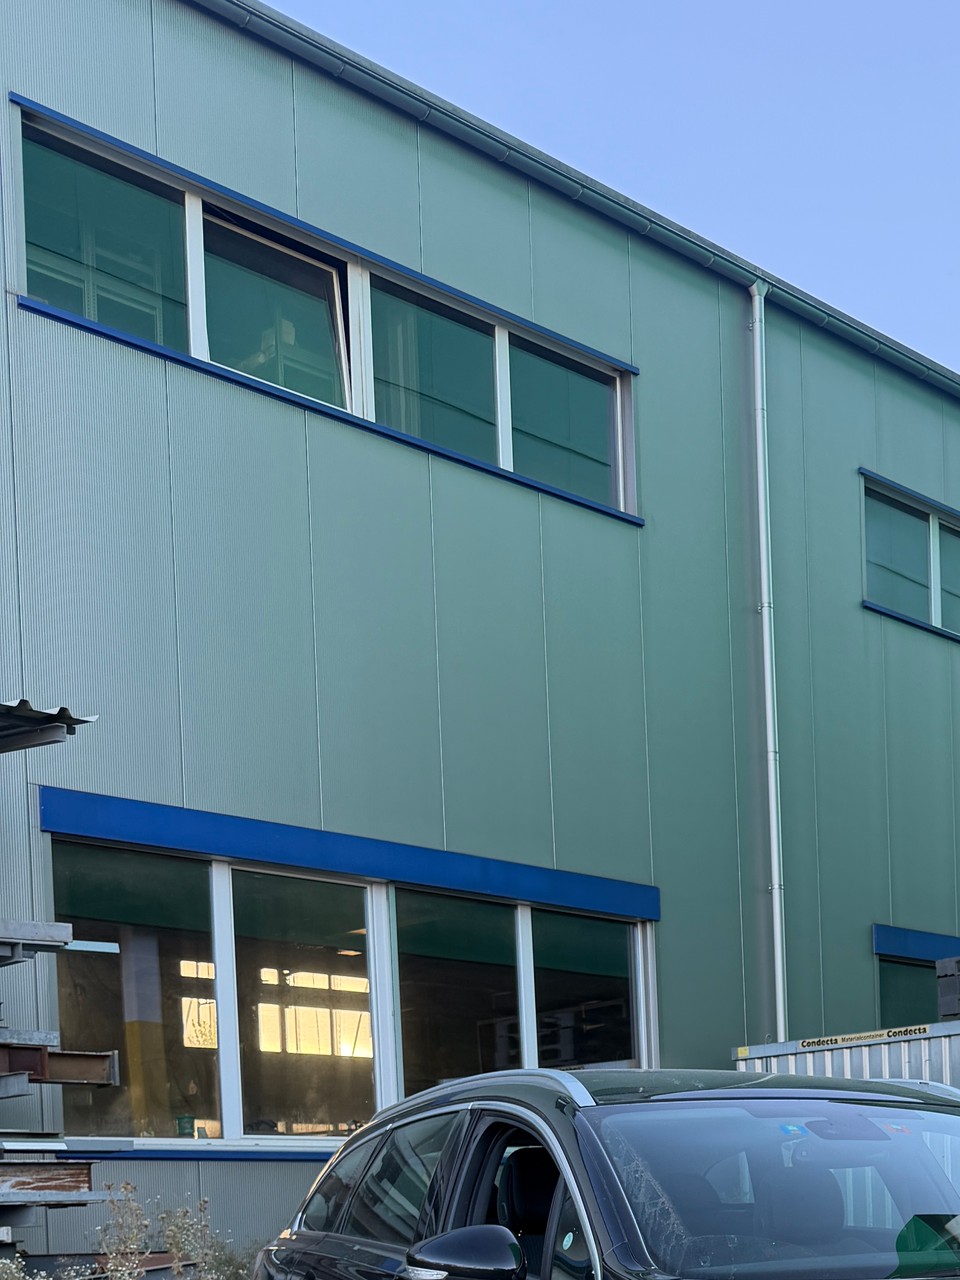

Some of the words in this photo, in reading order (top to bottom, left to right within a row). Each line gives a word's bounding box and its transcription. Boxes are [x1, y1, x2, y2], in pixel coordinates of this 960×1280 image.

[801, 1037, 838, 1048] Condecta
[841, 1033, 885, 1043] Materialcontainer
[887, 1026, 927, 1038] Condecta
